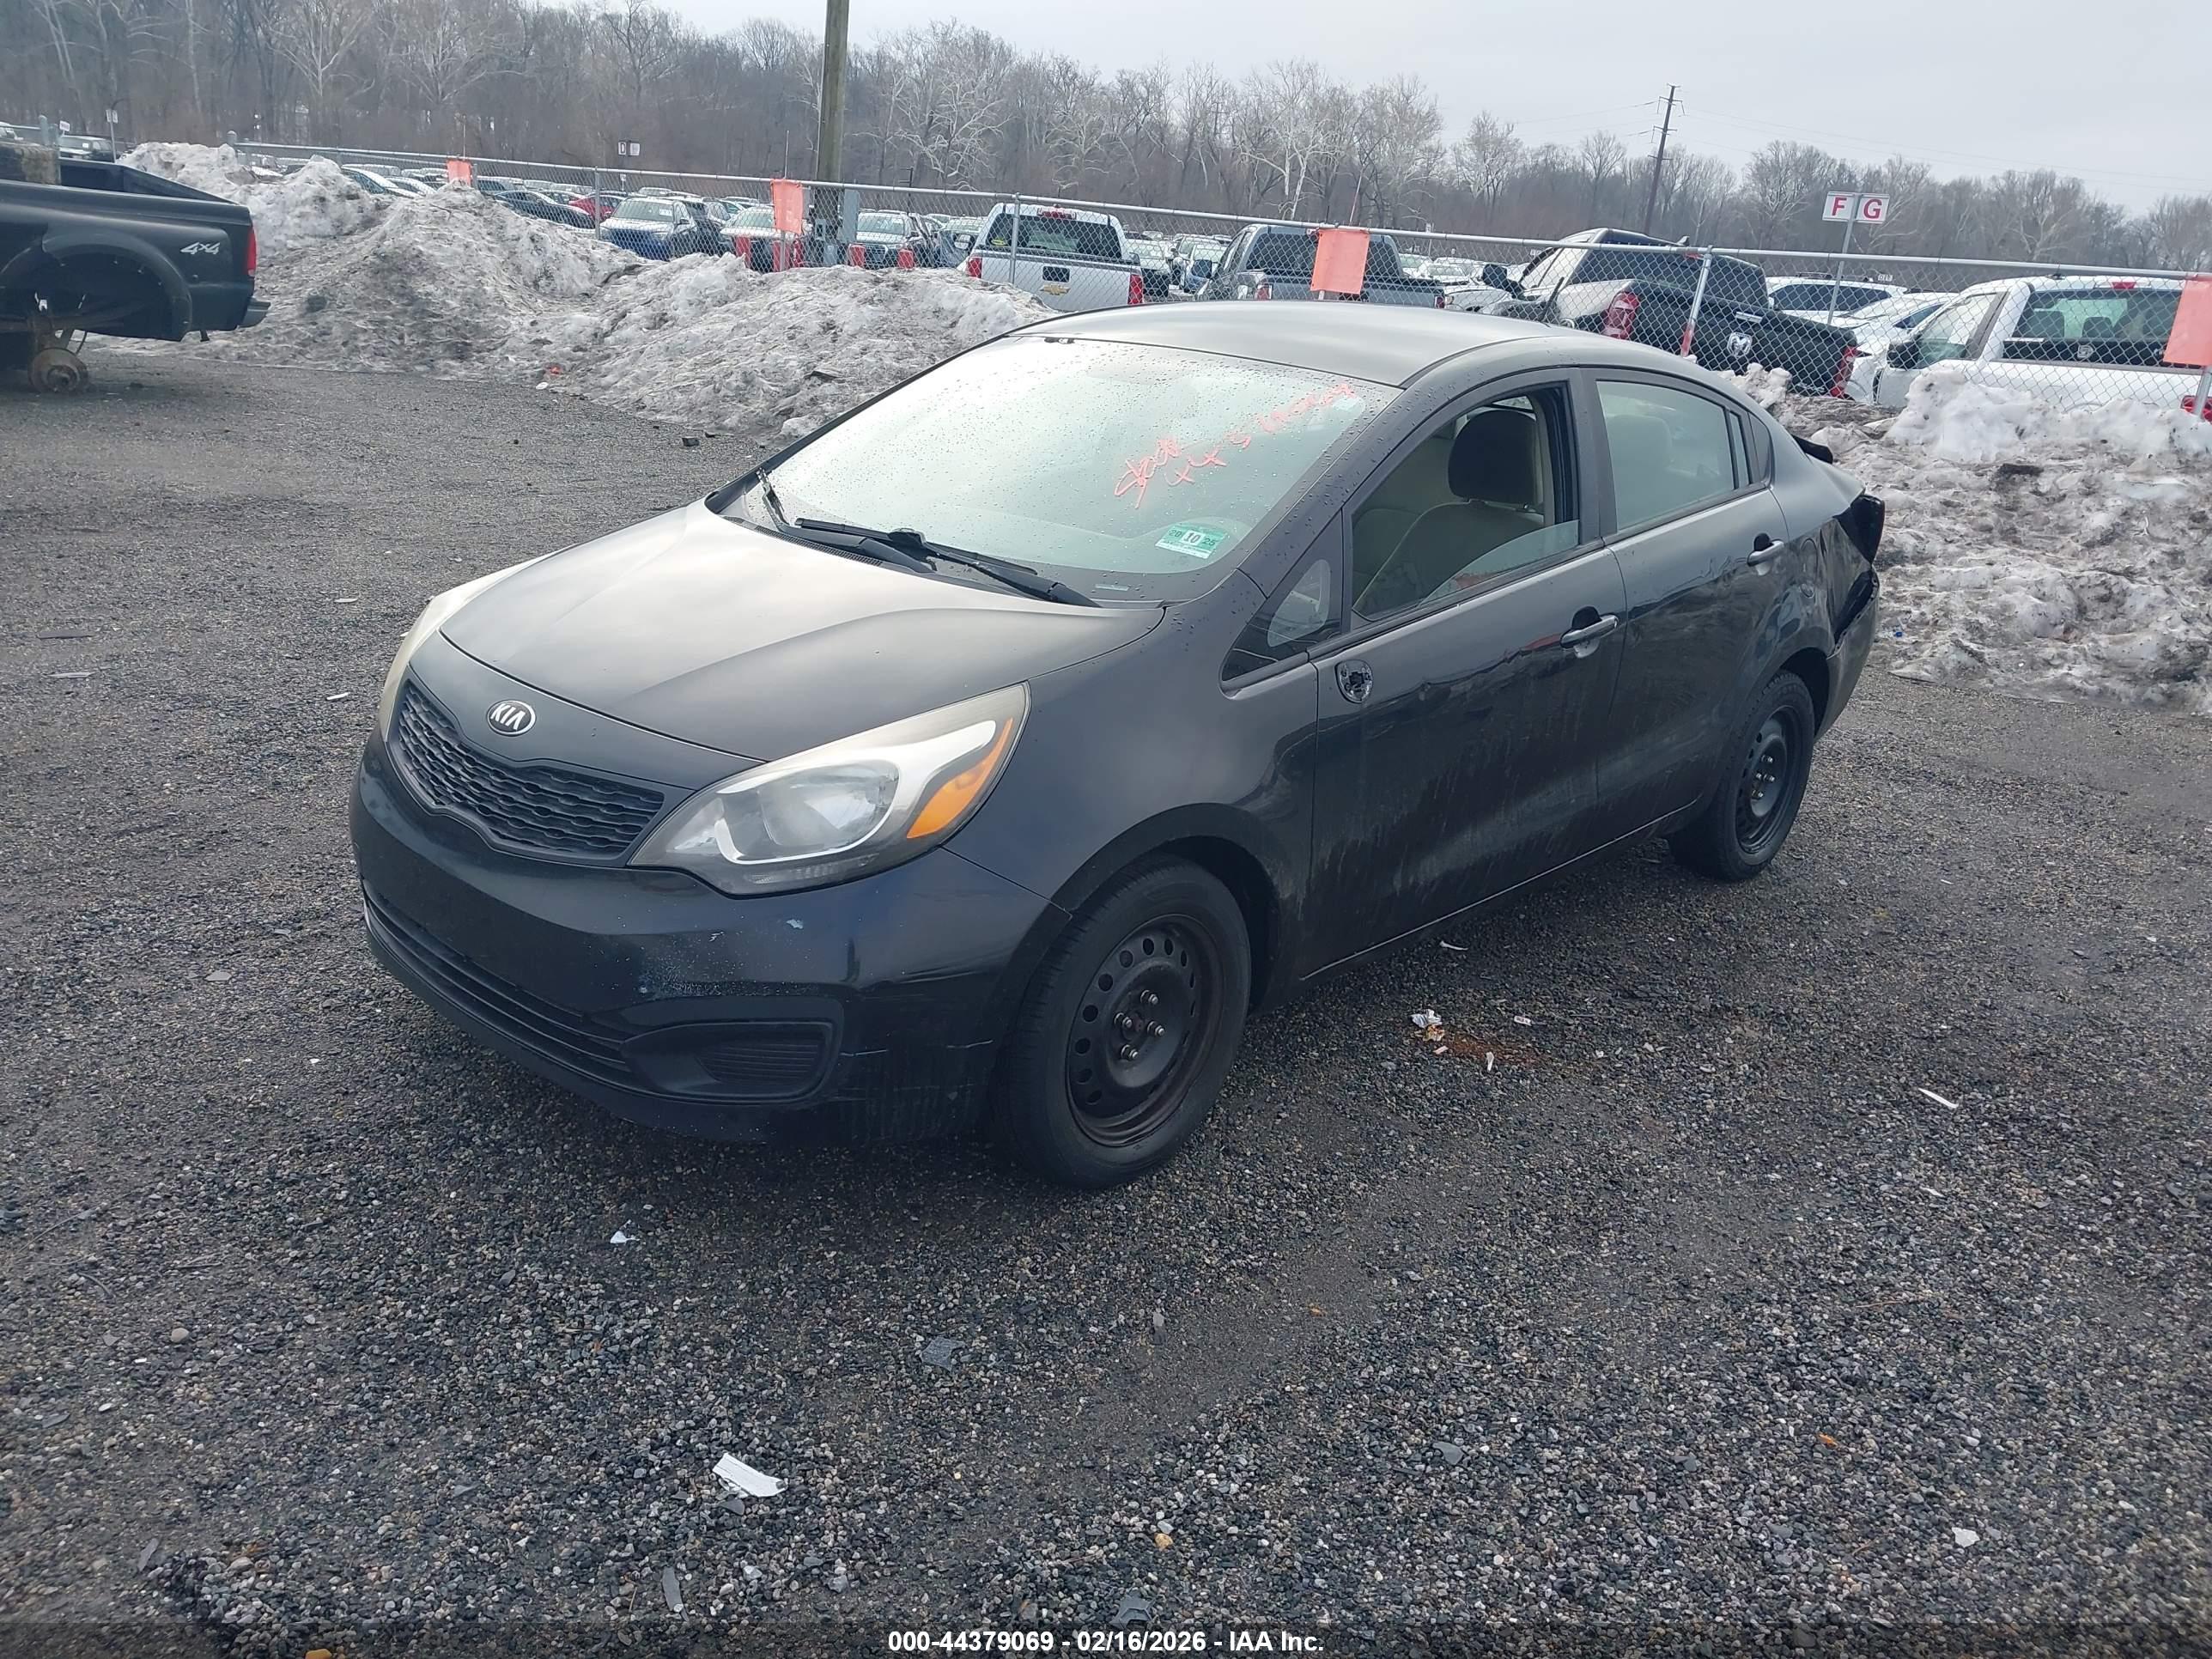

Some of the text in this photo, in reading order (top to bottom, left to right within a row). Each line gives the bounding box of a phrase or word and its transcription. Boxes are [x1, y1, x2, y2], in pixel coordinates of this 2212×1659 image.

[620, 143, 626, 154] D
[1832, 197, 1882, 219] F G
[1169, 529, 1216, 546] 20 10 25
[490, 702, 526, 731] KIA
